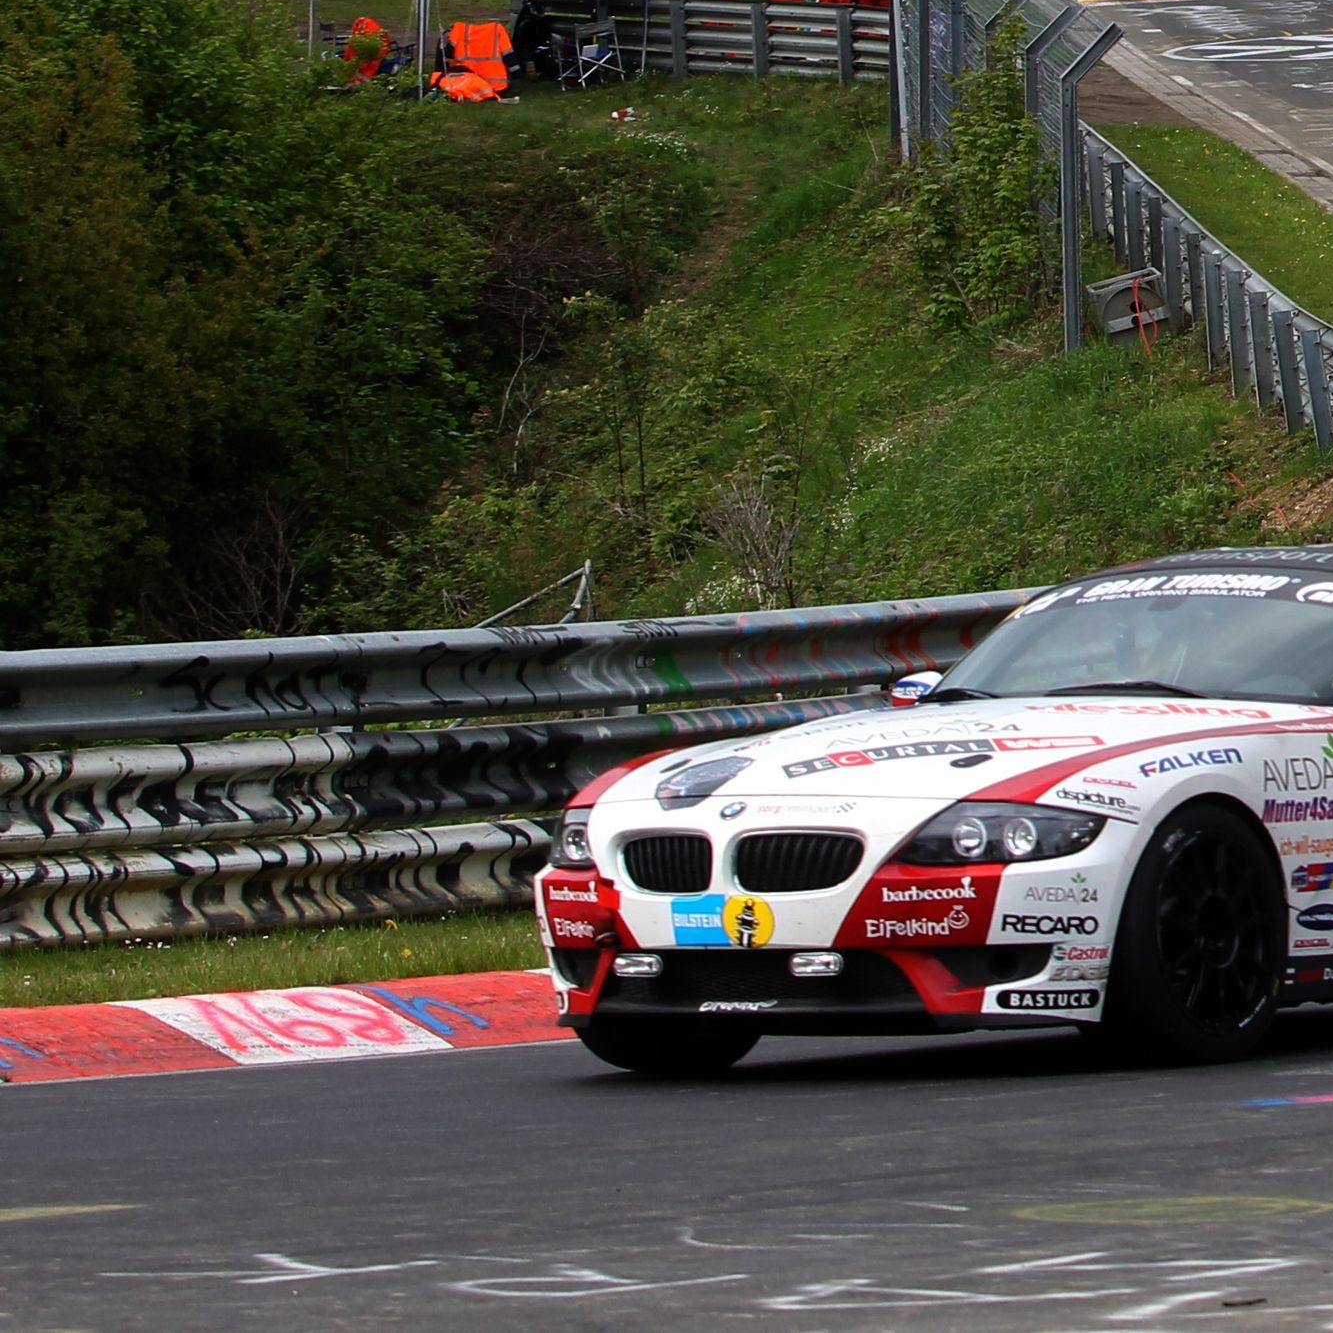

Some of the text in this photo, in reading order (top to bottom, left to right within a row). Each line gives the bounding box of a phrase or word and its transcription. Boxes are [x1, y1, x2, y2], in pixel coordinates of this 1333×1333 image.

[1082, 576, 1169, 598] GRAN
[1162, 574, 1291, 591] TURISMO
[1100, 591, 1131, 602] REAL
[1134, 587, 1189, 598] DRIVING
[1189, 588, 1268, 598] SIMULATOR
[973, 721, 1024, 734] 24
[785, 740, 991, 778] SECURTAL
[1138, 747, 1243, 778] FALKEN
[882, 876, 977, 903] barbecook
[1024, 886, 1099, 903] AVEDA 24
[672, 912, 722, 929] BILSTEIN
[864, 915, 950, 938] EiFelkind
[1001, 913, 1099, 936] RECARO
[1067, 945, 1109, 961] Castrol
[1009, 992, 1092, 1007] BASTUCK
